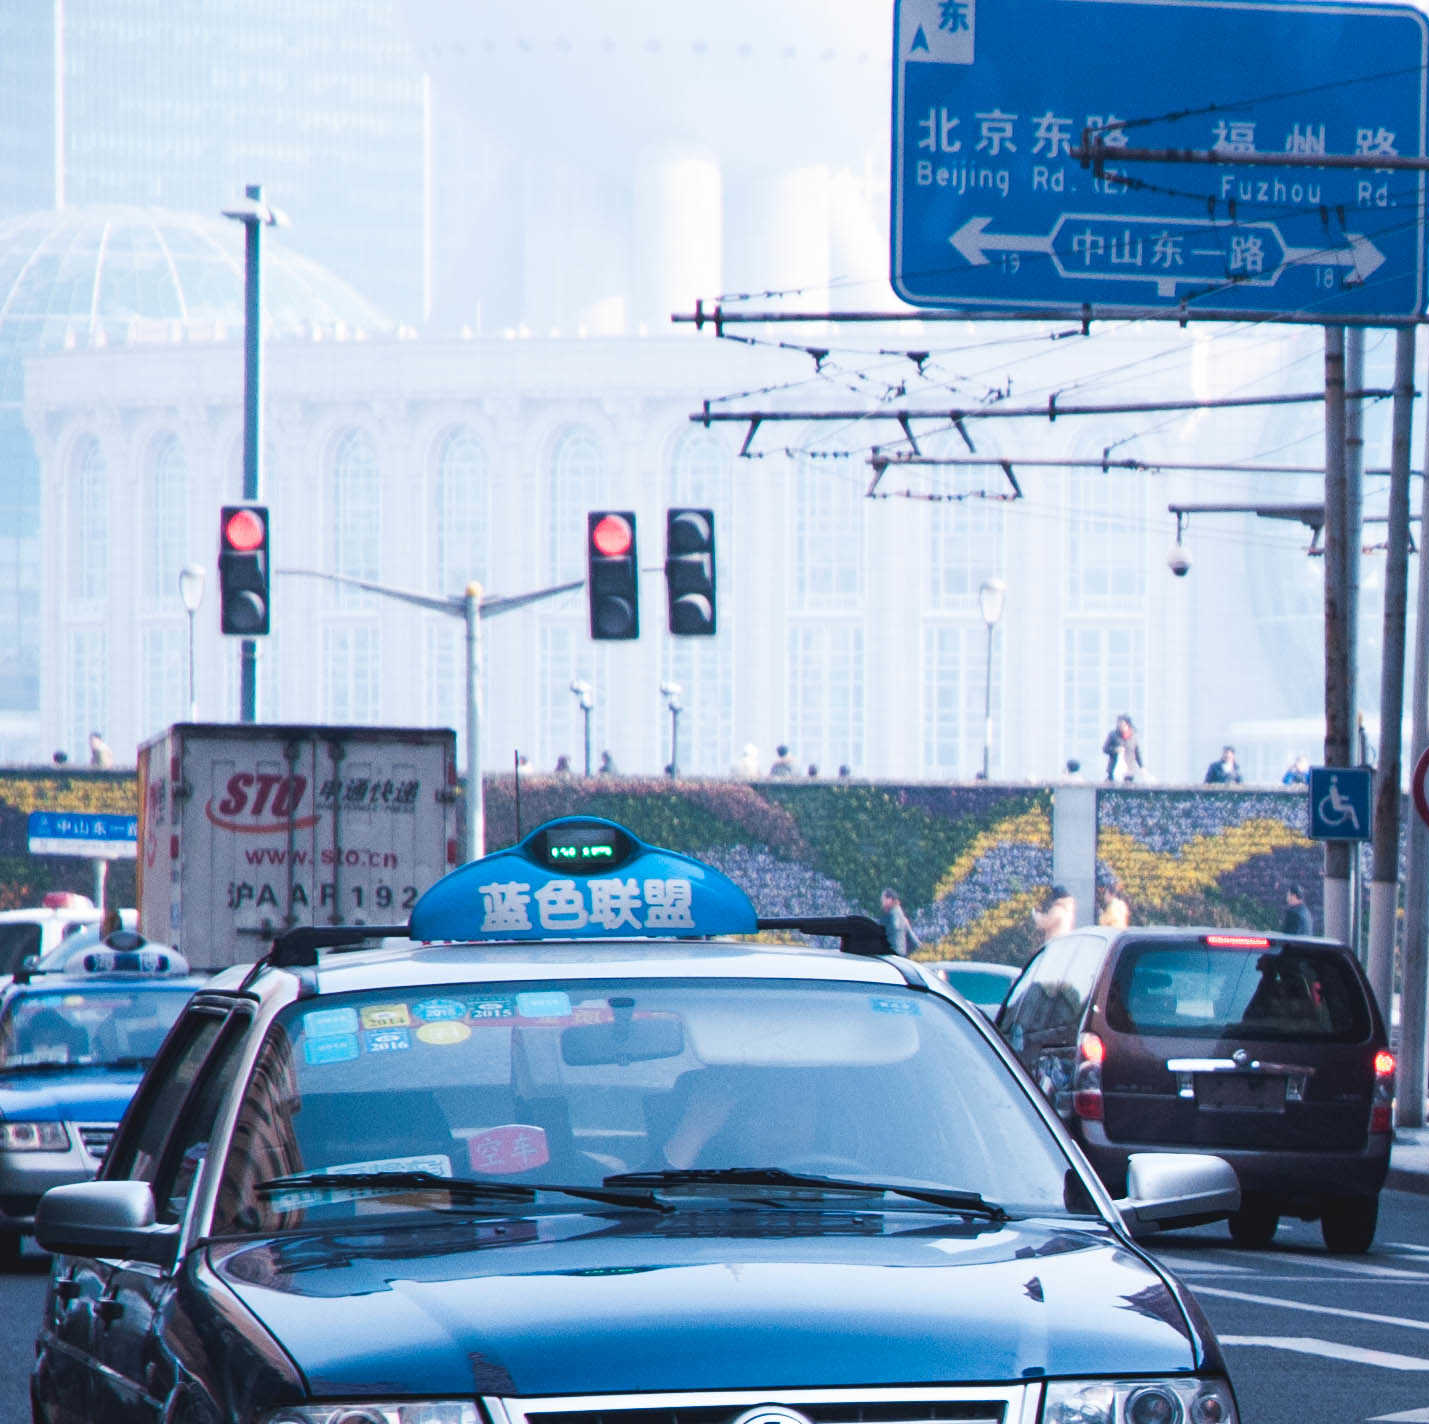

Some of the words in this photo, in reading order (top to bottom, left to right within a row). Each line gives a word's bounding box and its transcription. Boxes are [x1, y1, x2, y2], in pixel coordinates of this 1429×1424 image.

[938, 0, 970, 34] 东
[916, 160, 1011, 197] Beijing
[1032, 166, 1078, 193] Rd.
[1221, 174, 1321, 204] Fuzhou
[1357, 180, 1398, 208] Rd.
[1072, 227, 1266, 274] 中山东一路
[218, 772, 307, 818] STO
[245, 848, 398, 869] www.sto.cn
[479, 877, 695, 932] 蓝色联盟
[476, 1134, 538, 1169] 空车
